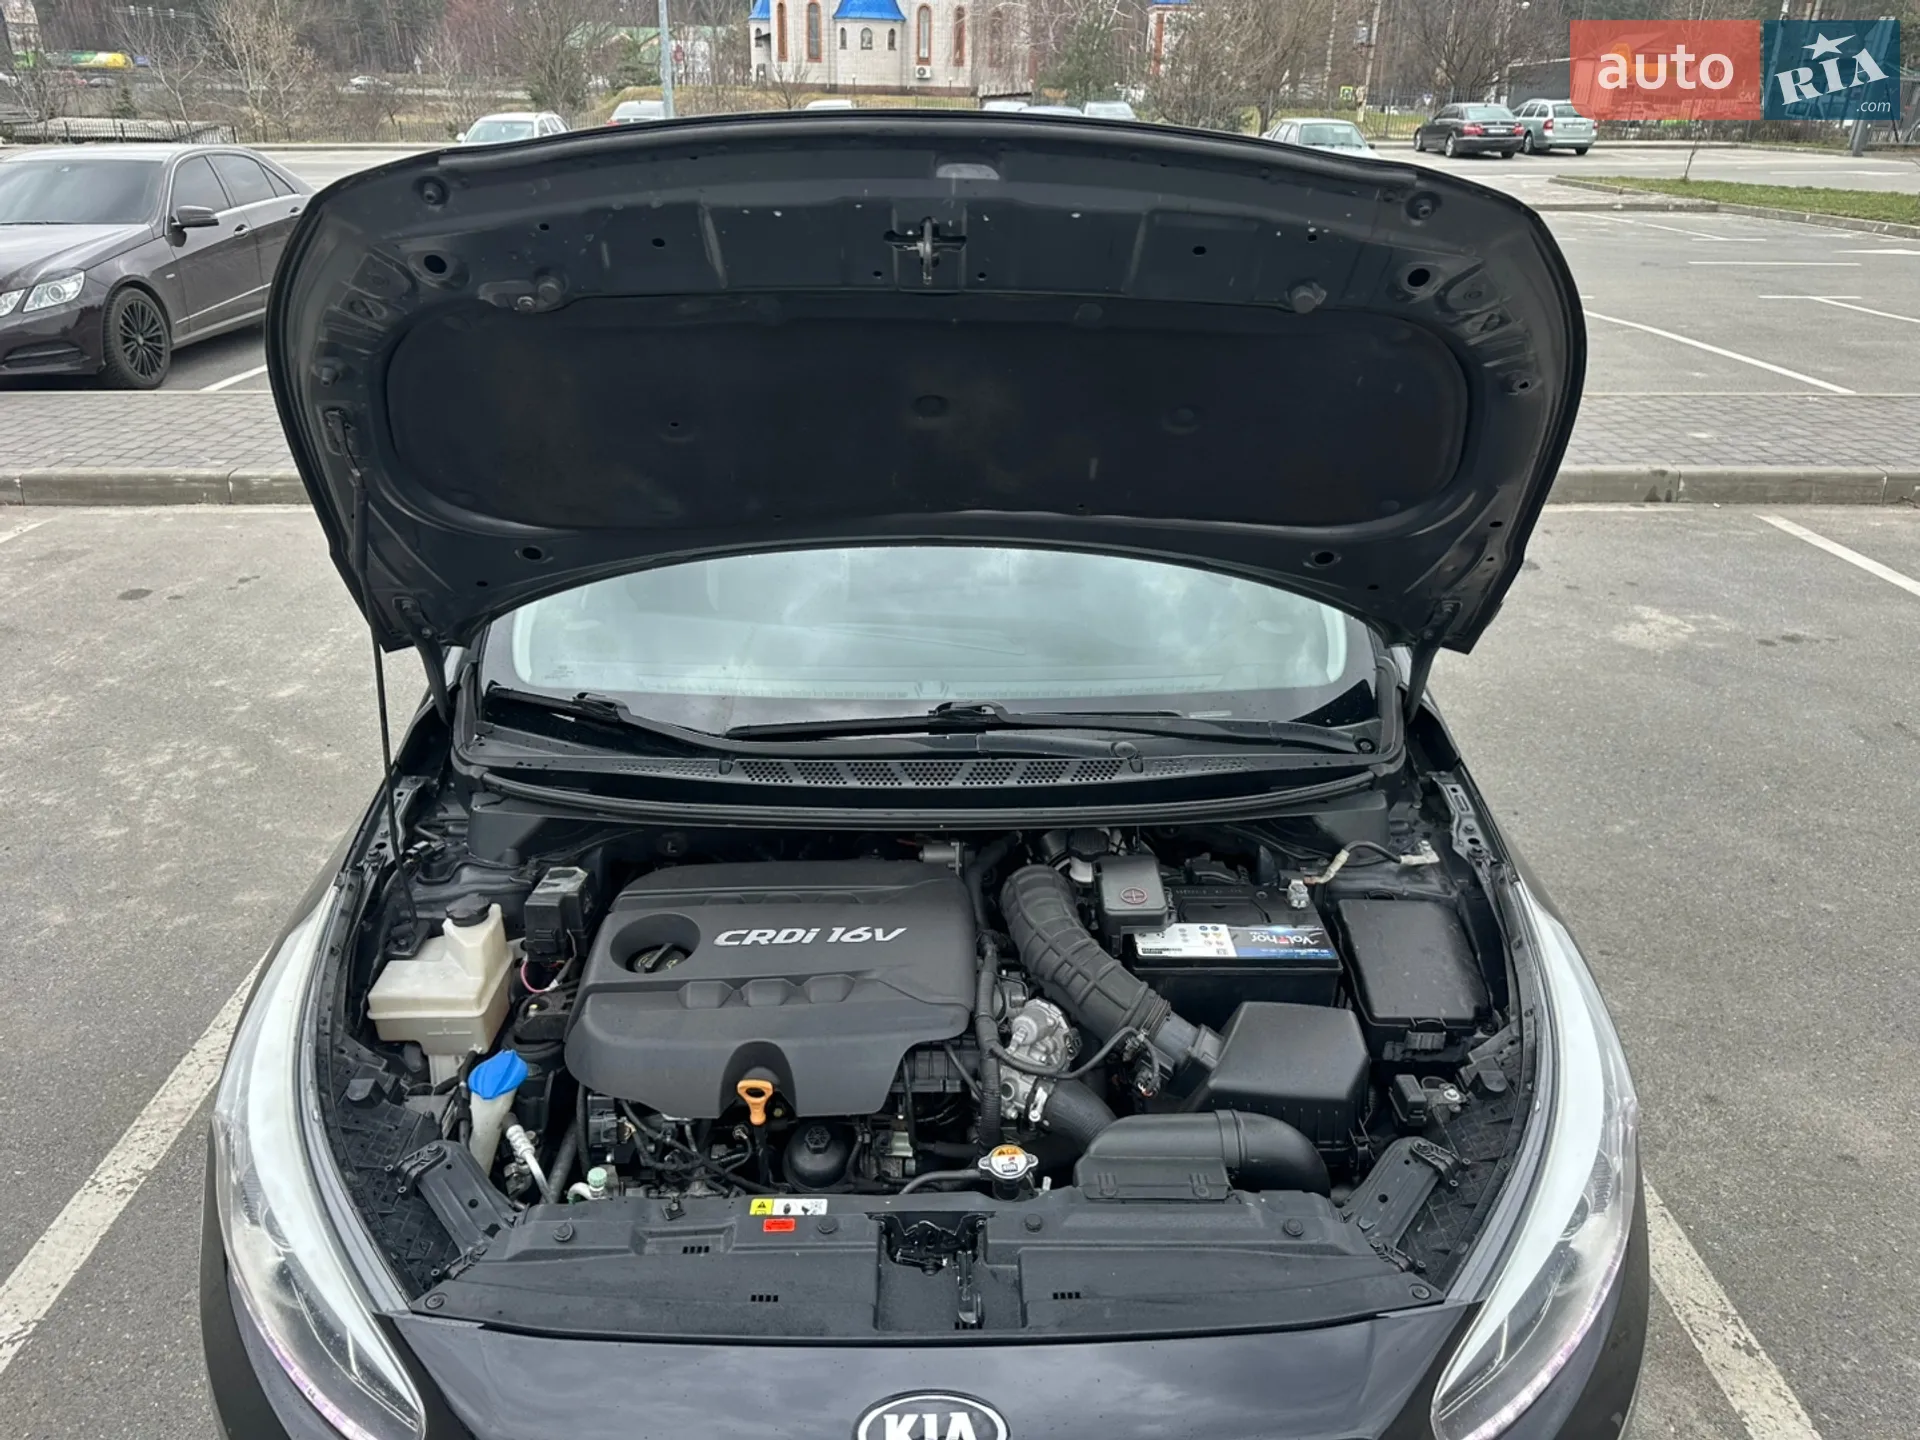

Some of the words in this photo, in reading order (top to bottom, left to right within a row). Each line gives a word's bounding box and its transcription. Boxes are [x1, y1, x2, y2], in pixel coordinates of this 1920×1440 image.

[713, 927, 821, 946] CRDi
[826, 926, 907, 943] 16V
[882, 1411, 975, 1440] KIA
